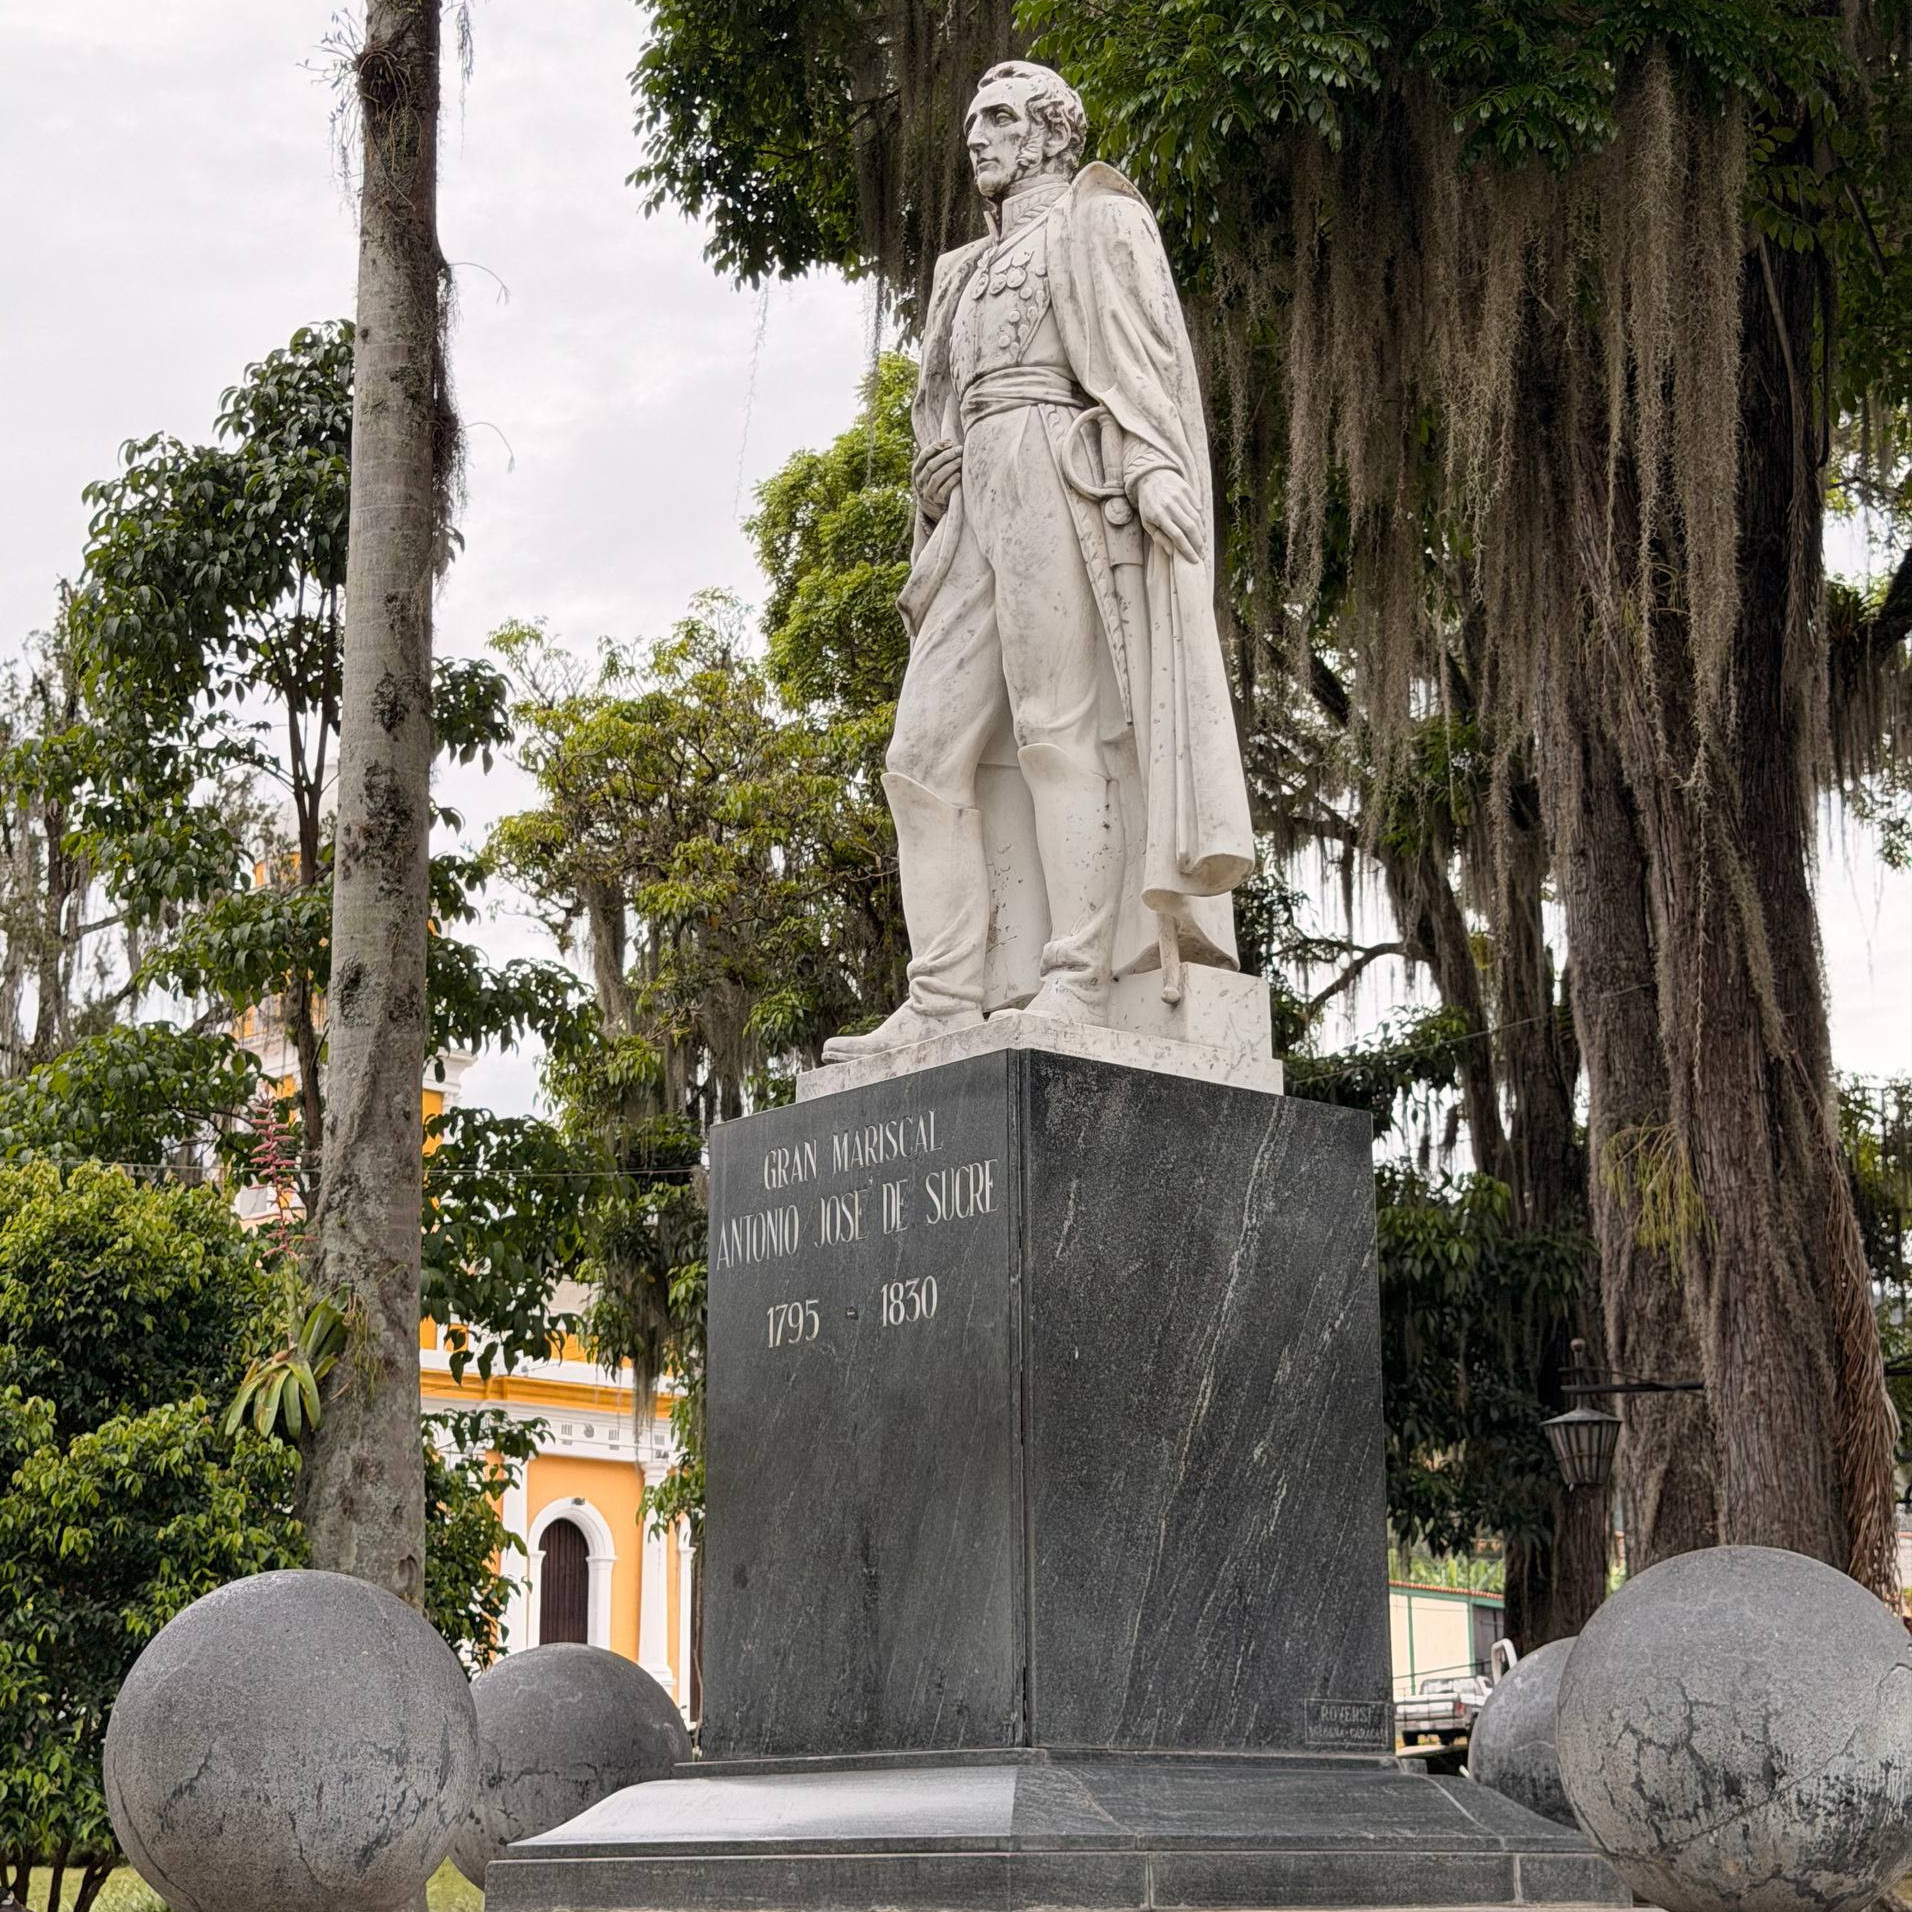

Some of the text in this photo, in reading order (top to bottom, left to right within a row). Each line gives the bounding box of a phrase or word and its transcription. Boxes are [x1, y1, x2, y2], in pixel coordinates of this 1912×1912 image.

[763, 1108, 943, 1190] GRAN MARISCAL
[716, 1205, 799, 1271] ANTONIO
[882, 1179, 909, 1235] DE
[925, 1159, 999, 1225] SUCRE
[767, 1299, 819, 1349] 1795
[880, 1275, 938, 1327] 1830
